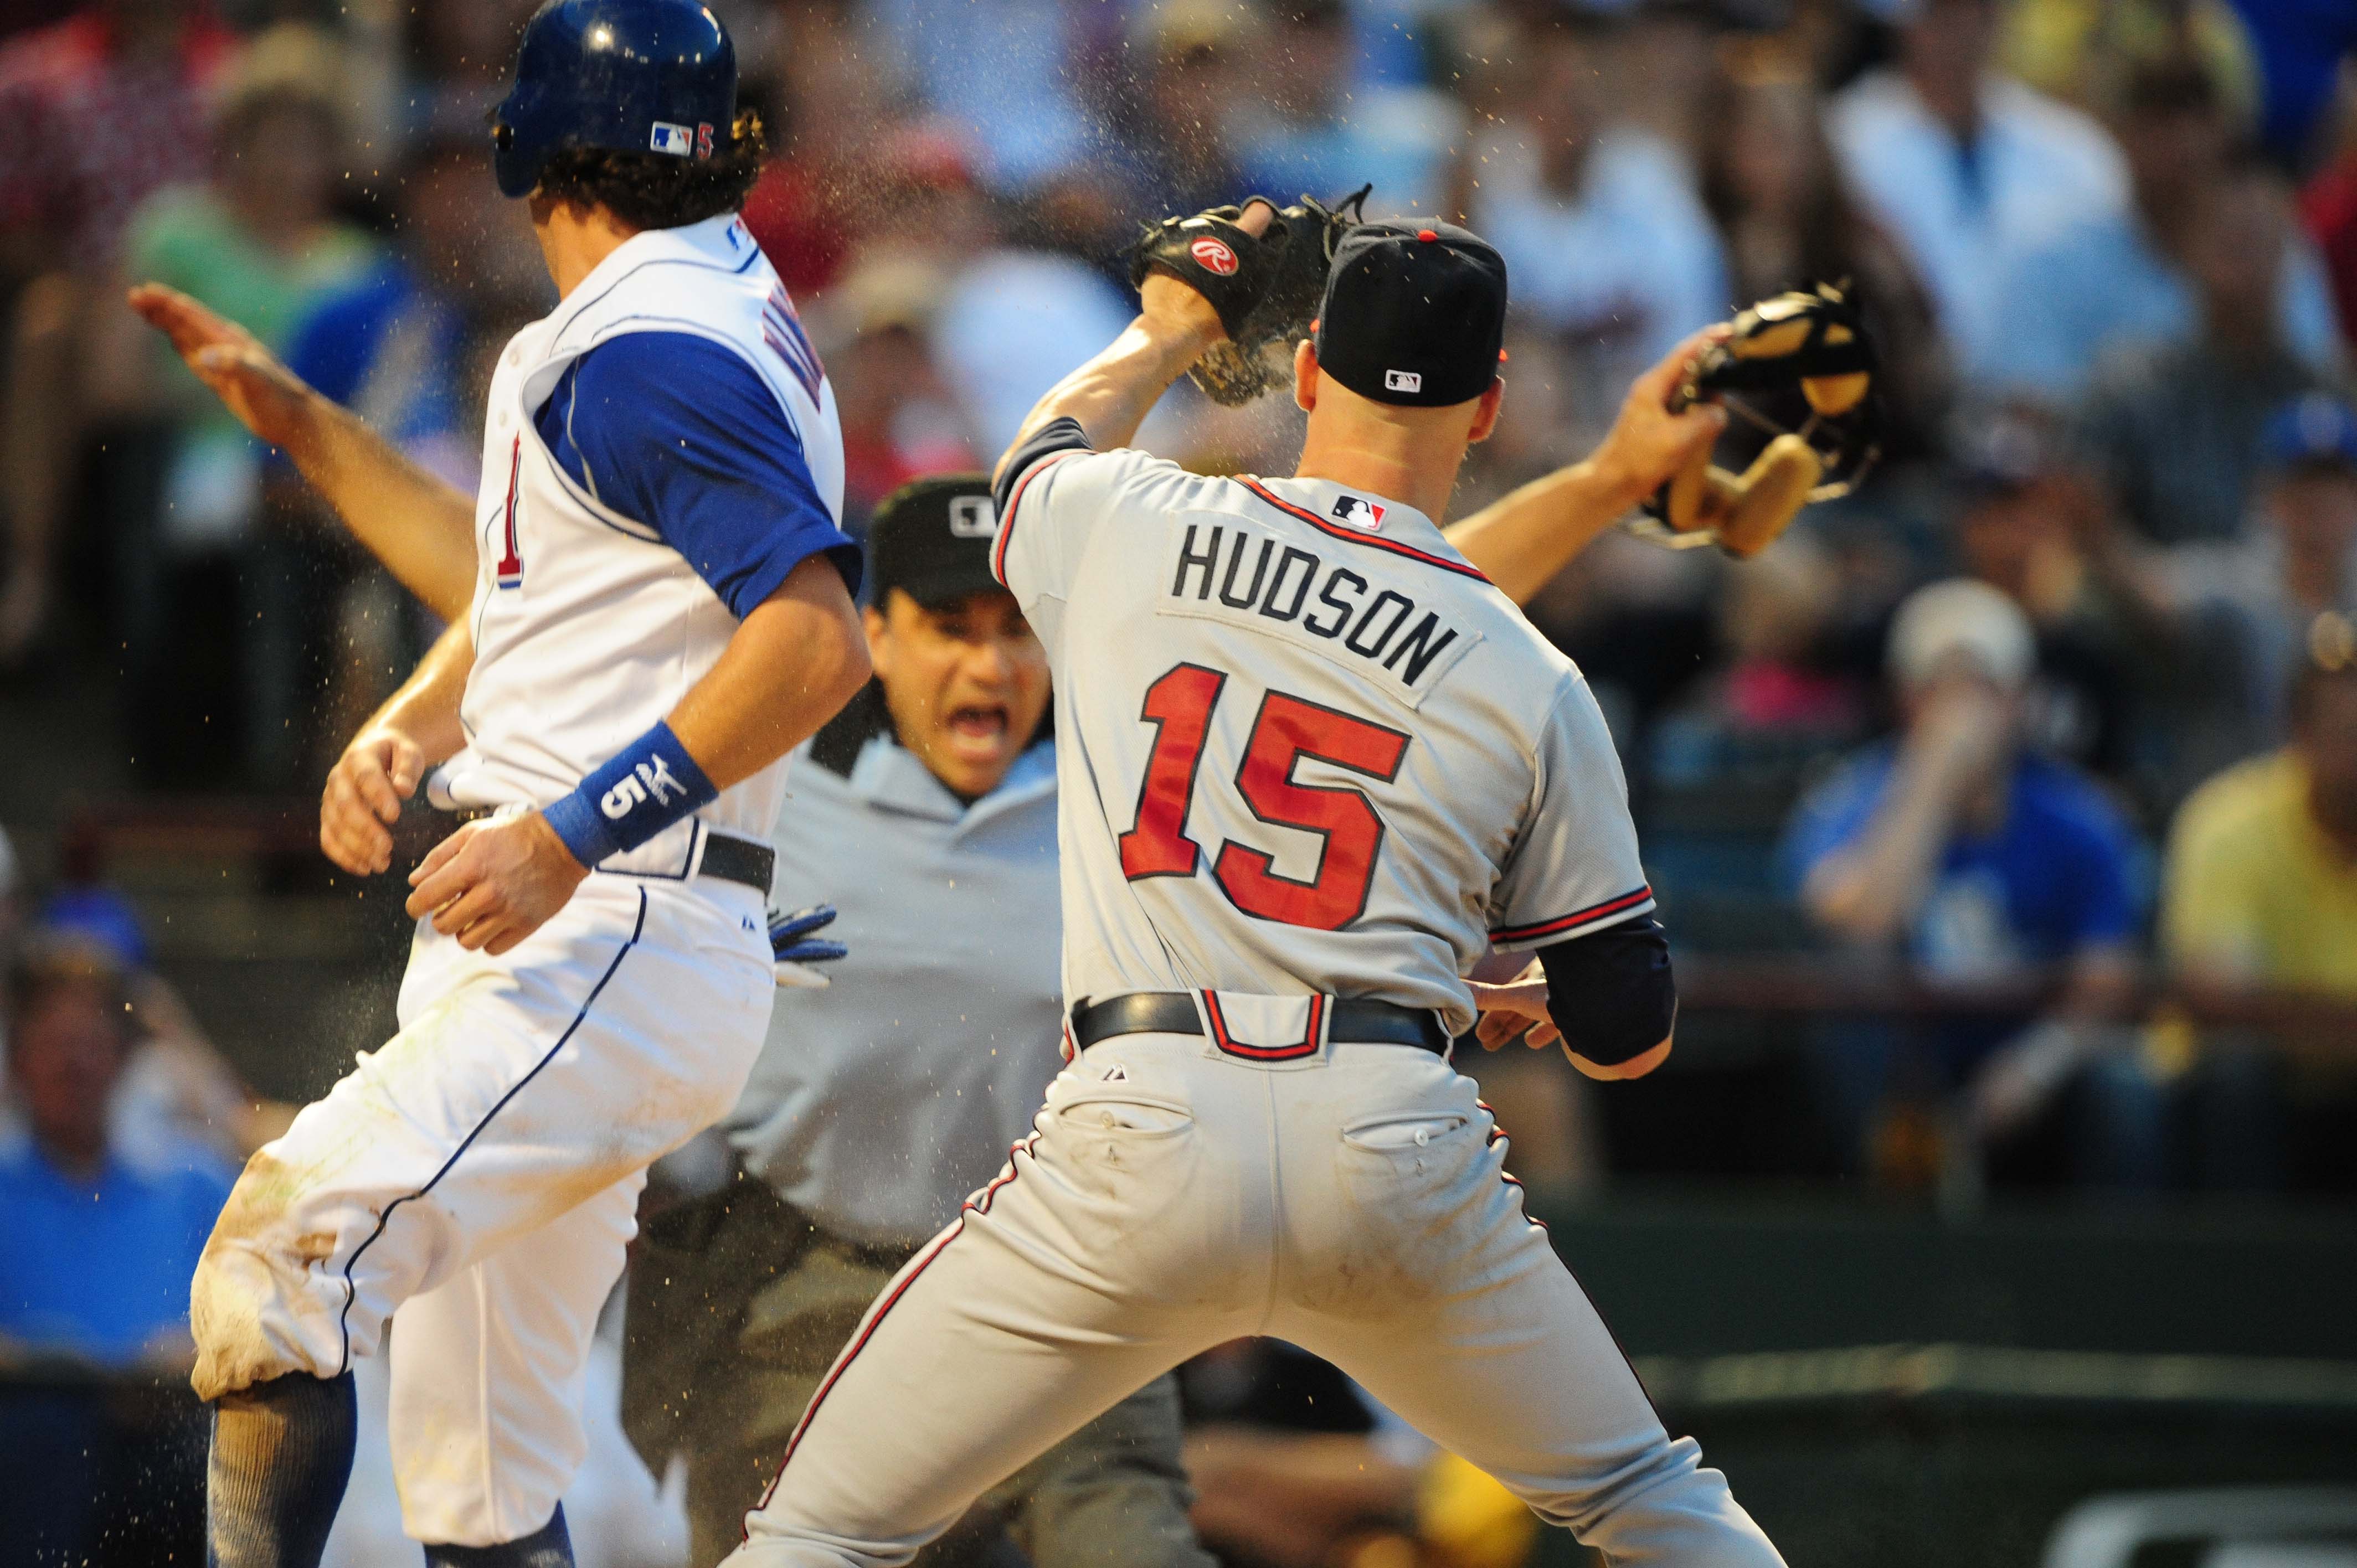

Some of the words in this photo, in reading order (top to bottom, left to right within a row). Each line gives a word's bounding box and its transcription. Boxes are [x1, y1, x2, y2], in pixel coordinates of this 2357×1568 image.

[697, 121, 714, 160] 5
[1172, 524, 1459, 687] HUDSON
[601, 773, 647, 819] 5
[1118, 661, 1413, 932] 15
